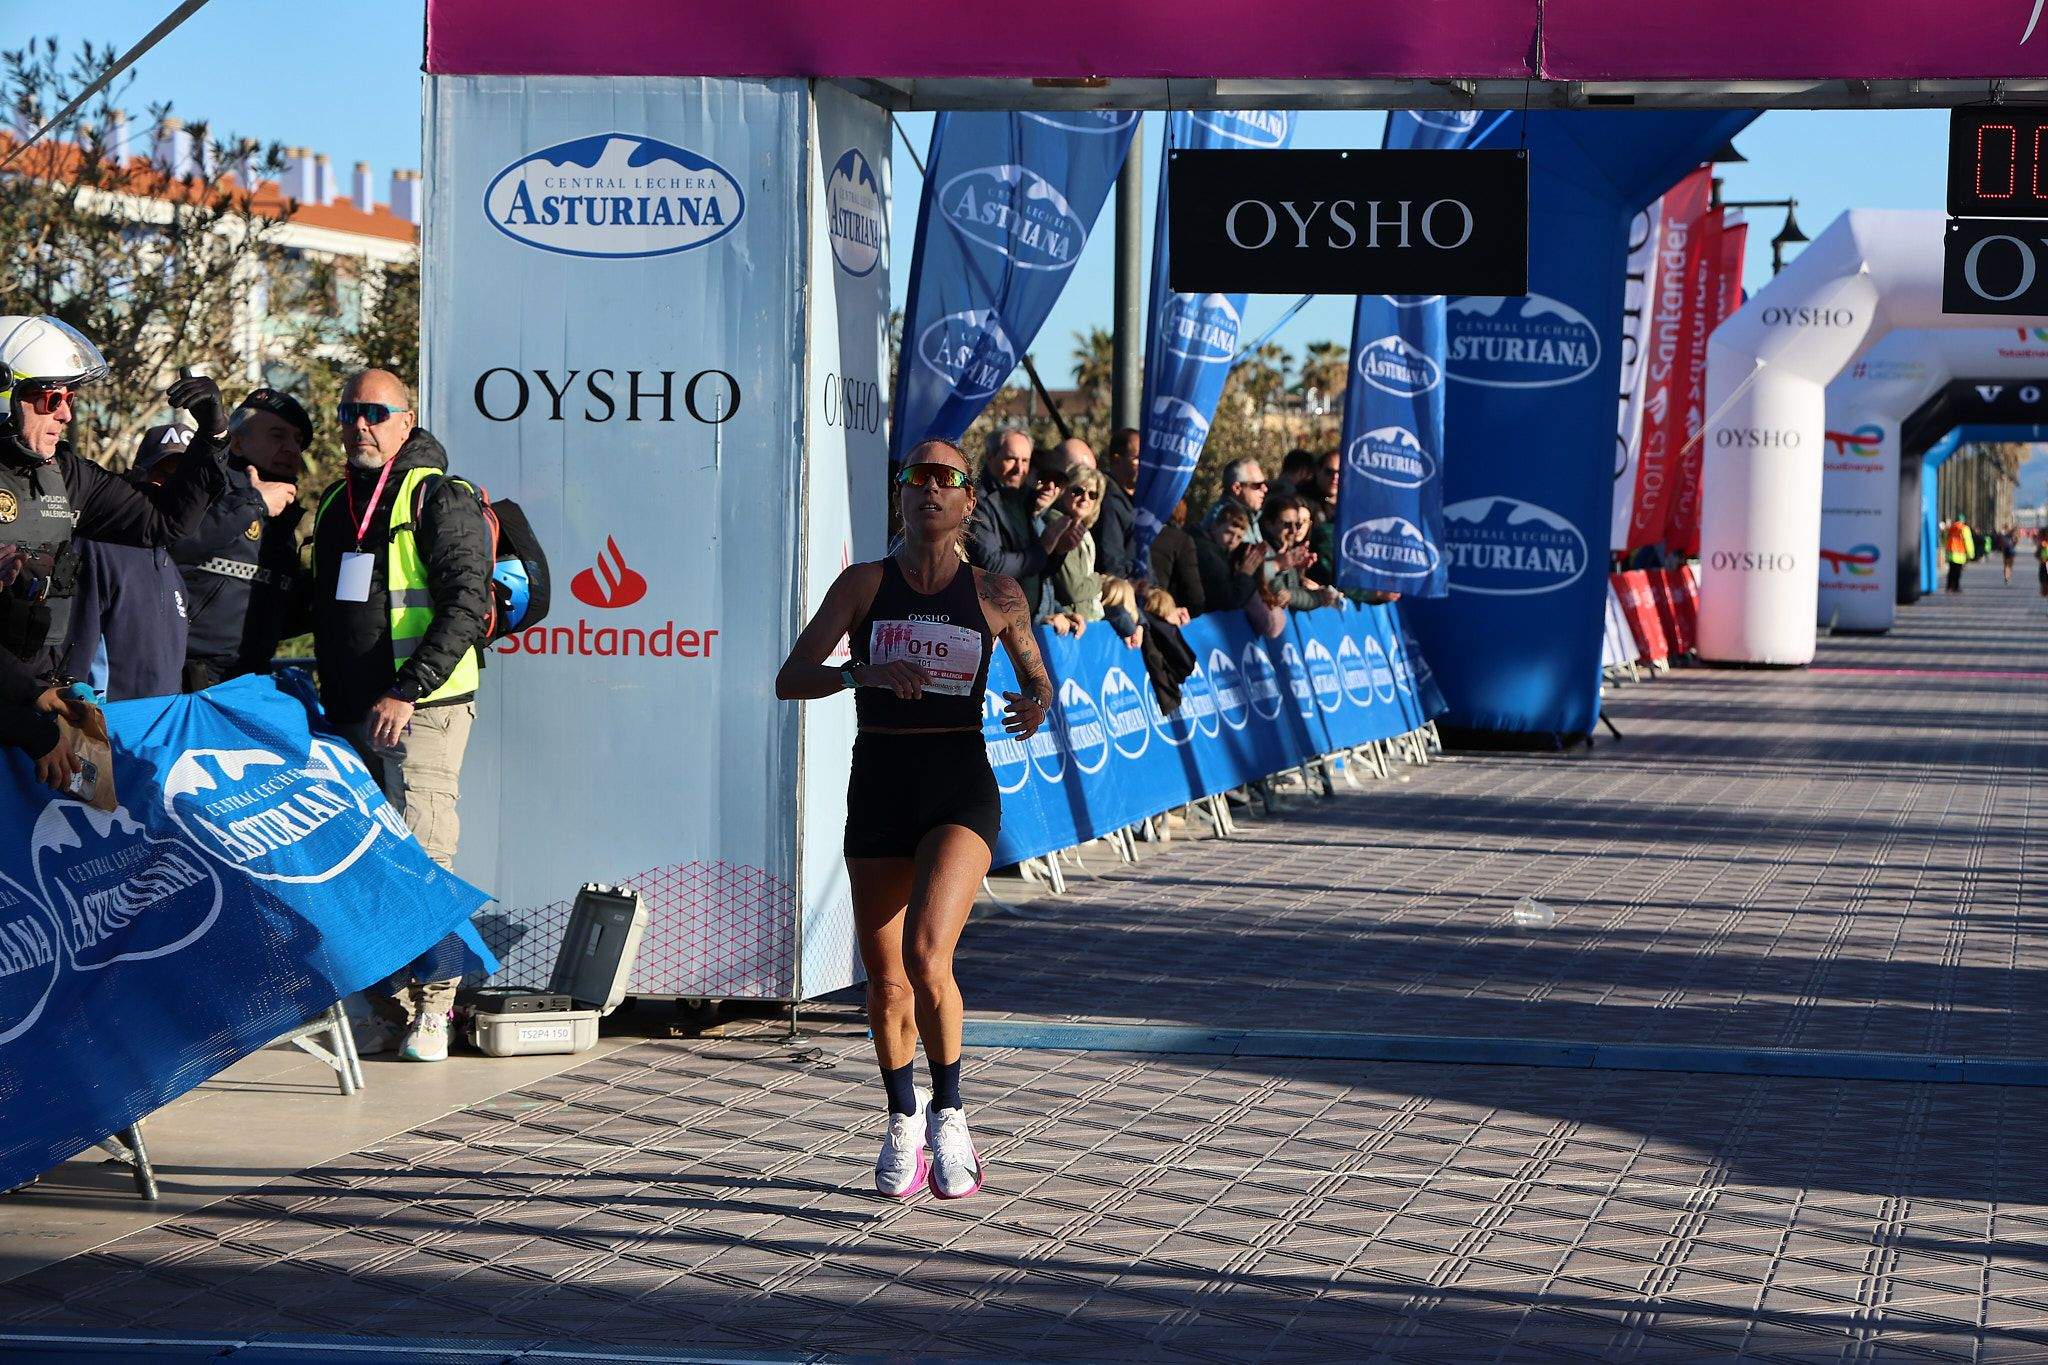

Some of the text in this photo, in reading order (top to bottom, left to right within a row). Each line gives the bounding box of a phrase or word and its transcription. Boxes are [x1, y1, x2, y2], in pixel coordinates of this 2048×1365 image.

[545, 177, 717, 189] CENTRAL LECHERA
[504, 179, 725, 226] ASTURIANA
[830, 188, 879, 249] ASTURIANA
[1225, 199, 1473, 250] OYSHO
[1652, 217, 1689, 382] Santander
[1762, 306, 1853, 329] OYSHO
[473, 367, 742, 424] OYSHO
[823, 373, 880, 435] OYSHO
[1716, 428, 1800, 449] OYSHO
[1444, 542, 1576, 573] STURIANA
[1711, 550, 1796, 572] OYSHO
[908, 613, 950, 622] OYSHO
[497, 619, 719, 658] Santander
[908, 640, 949, 658] 016
[206, 792, 257, 816] CENTRAL
[193, 784, 355, 864] ASTURIAN
[67, 856, 115, 883] CENTRAL
[553, 1029, 569, 1038] 150
